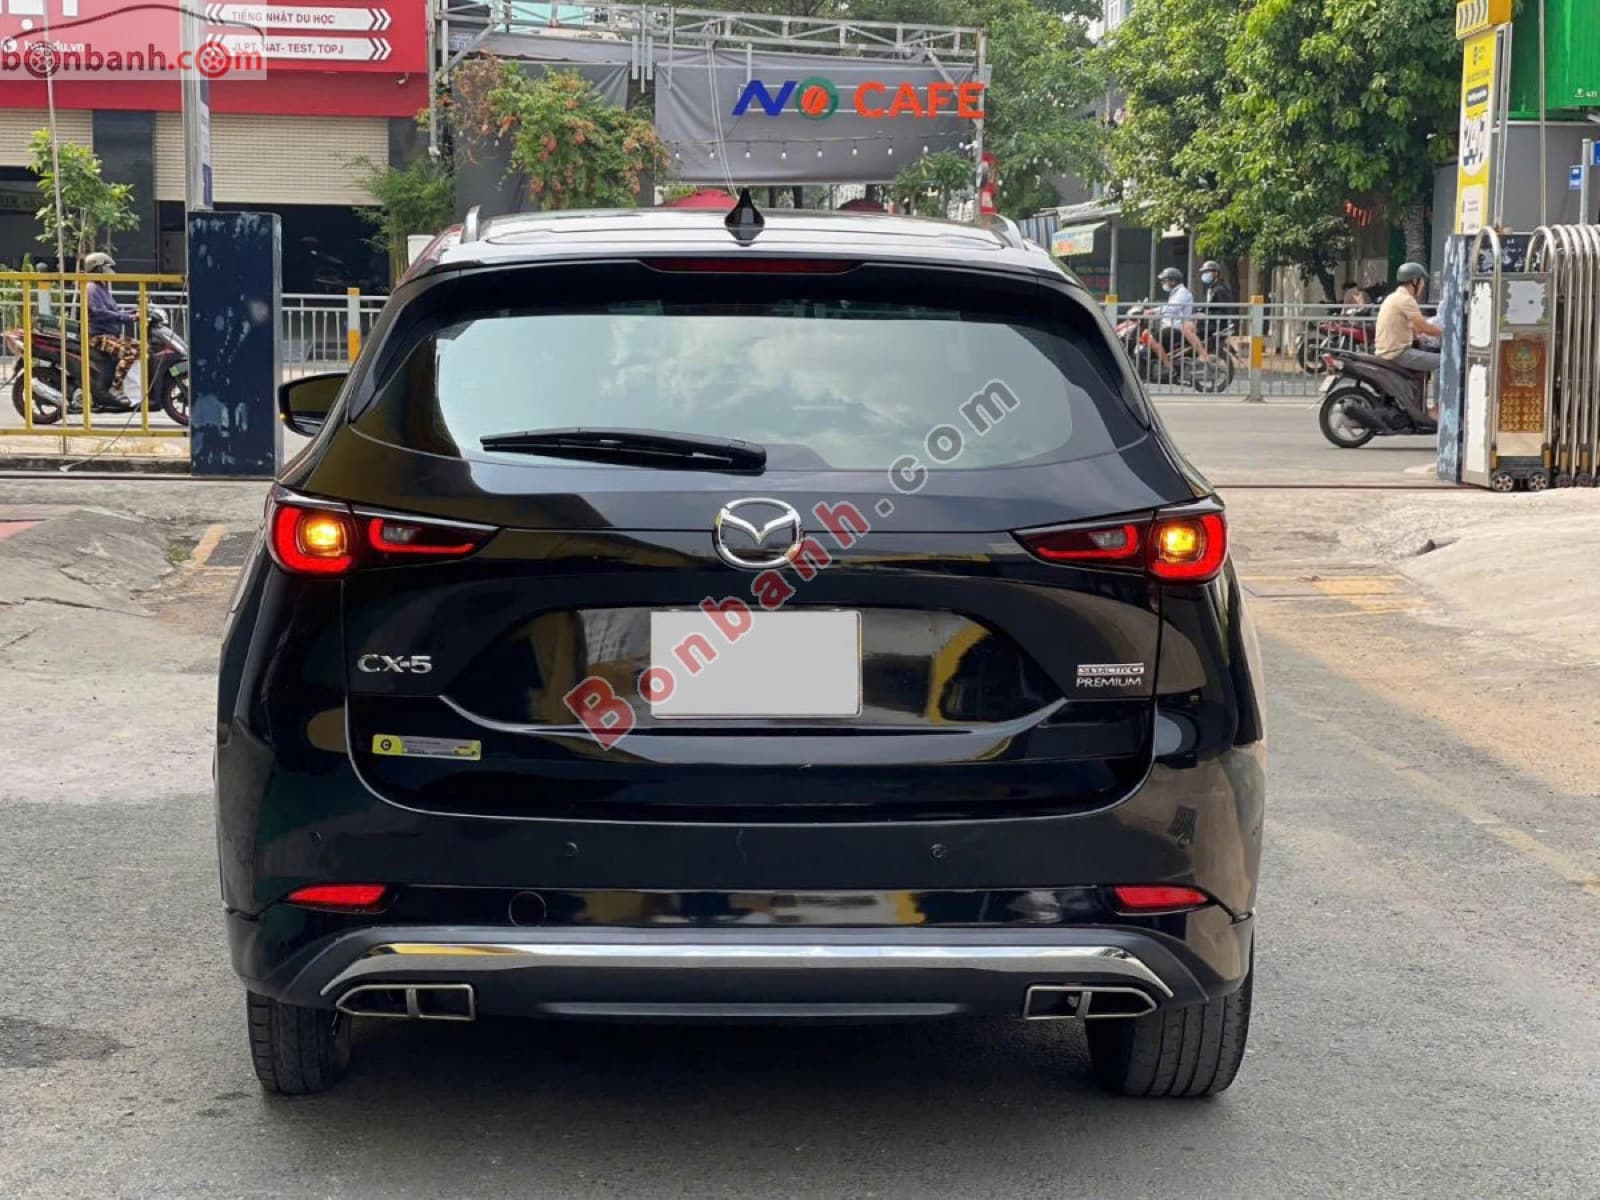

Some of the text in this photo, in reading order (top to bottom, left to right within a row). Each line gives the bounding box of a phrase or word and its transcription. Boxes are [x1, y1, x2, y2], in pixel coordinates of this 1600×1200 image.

[231, 9, 262, 22] TIẾNG
[296, 13, 311, 23] DU
[319, 46, 343, 54] TOPJ
[854, 81, 985, 118] CAFE
[357, 654, 433, 673] CX-5
[1076, 677, 1142, 687] PREMIUM
